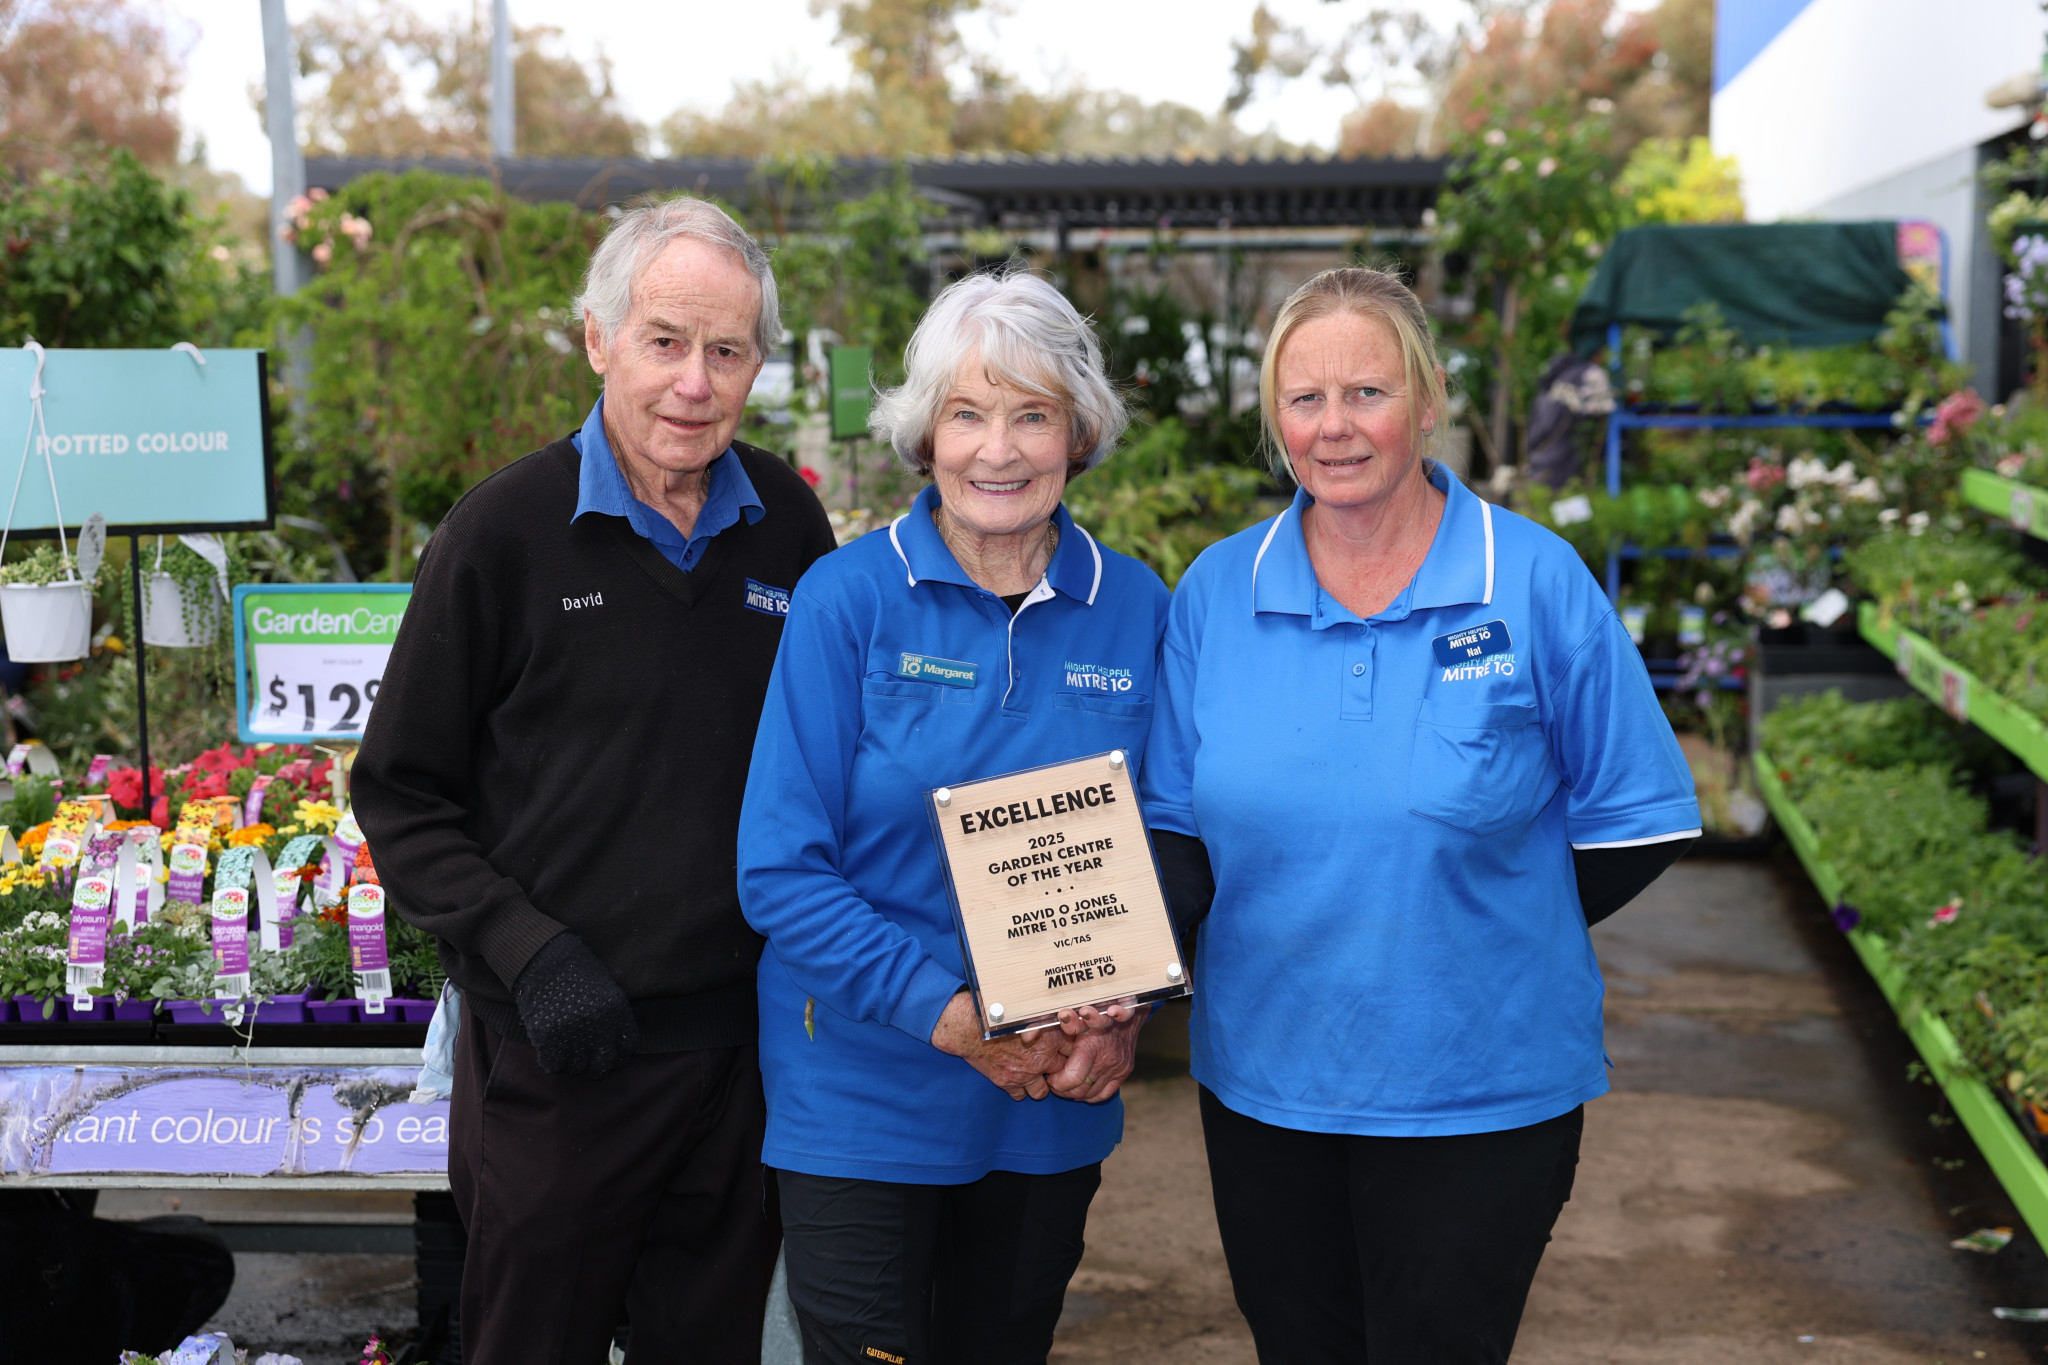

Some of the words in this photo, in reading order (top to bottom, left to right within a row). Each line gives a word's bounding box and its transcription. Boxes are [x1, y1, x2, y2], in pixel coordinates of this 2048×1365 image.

[36, 433, 129, 456] POTTED
[136, 431, 229, 454] COLOUR
[562, 592, 603, 611] David
[746, 591, 774, 612] MITRE
[775, 599, 790, 613] 10
[252, 606, 404, 635] GardenCent
[1450, 635, 1478, 649] MITRE
[1479, 631, 1491, 641] 10
[1466, 646, 1482, 658] Nat
[902, 661, 921, 675] 10
[924, 663, 975, 680] Margaret
[1064, 660, 1096, 673] MIGHTY
[1098, 665, 1133, 678] HELPFUL
[1442, 663, 1490, 682] MITRE
[1494, 661, 1514, 676] 10
[1066, 671, 1108, 691] MITRE
[1111, 677, 1133, 692] 10
[960, 783, 1116, 834] EXCELLENCE
[1028, 832, 1065, 849] 2025
[988, 851, 1053, 874] GARDEN
[1057, 838, 1113, 859] CENTRE
[1007, 872, 1028, 887] OF
[1031, 866, 1061, 882] THE
[1064, 857, 1103, 875] YEAR
[72, 914, 106, 925] alyssum
[1011, 907, 1054, 925] DAVID
[1059, 904, 1070, 916] O
[1074, 893, 1117, 912] JONES
[349, 923, 384, 933] marigold
[1007, 921, 1047, 939] MITRE
[1051, 918, 1067, 930] 10
[1071, 903, 1129, 925] STAWELL
[1053, 933, 1092, 948] VIC/TAS
[1044, 963, 1077, 977] MIGHTY
[1079, 955, 1113, 968] HELPFUL
[1047, 967, 1094, 989] MITRE
[1096, 963, 1116, 977] 10
[151, 1108, 281, 1144] colour
[334, 1116, 384, 1144] so
[396, 1115, 448, 1144] ea
[866, 1346, 903, 1365] CATERPILLAR
